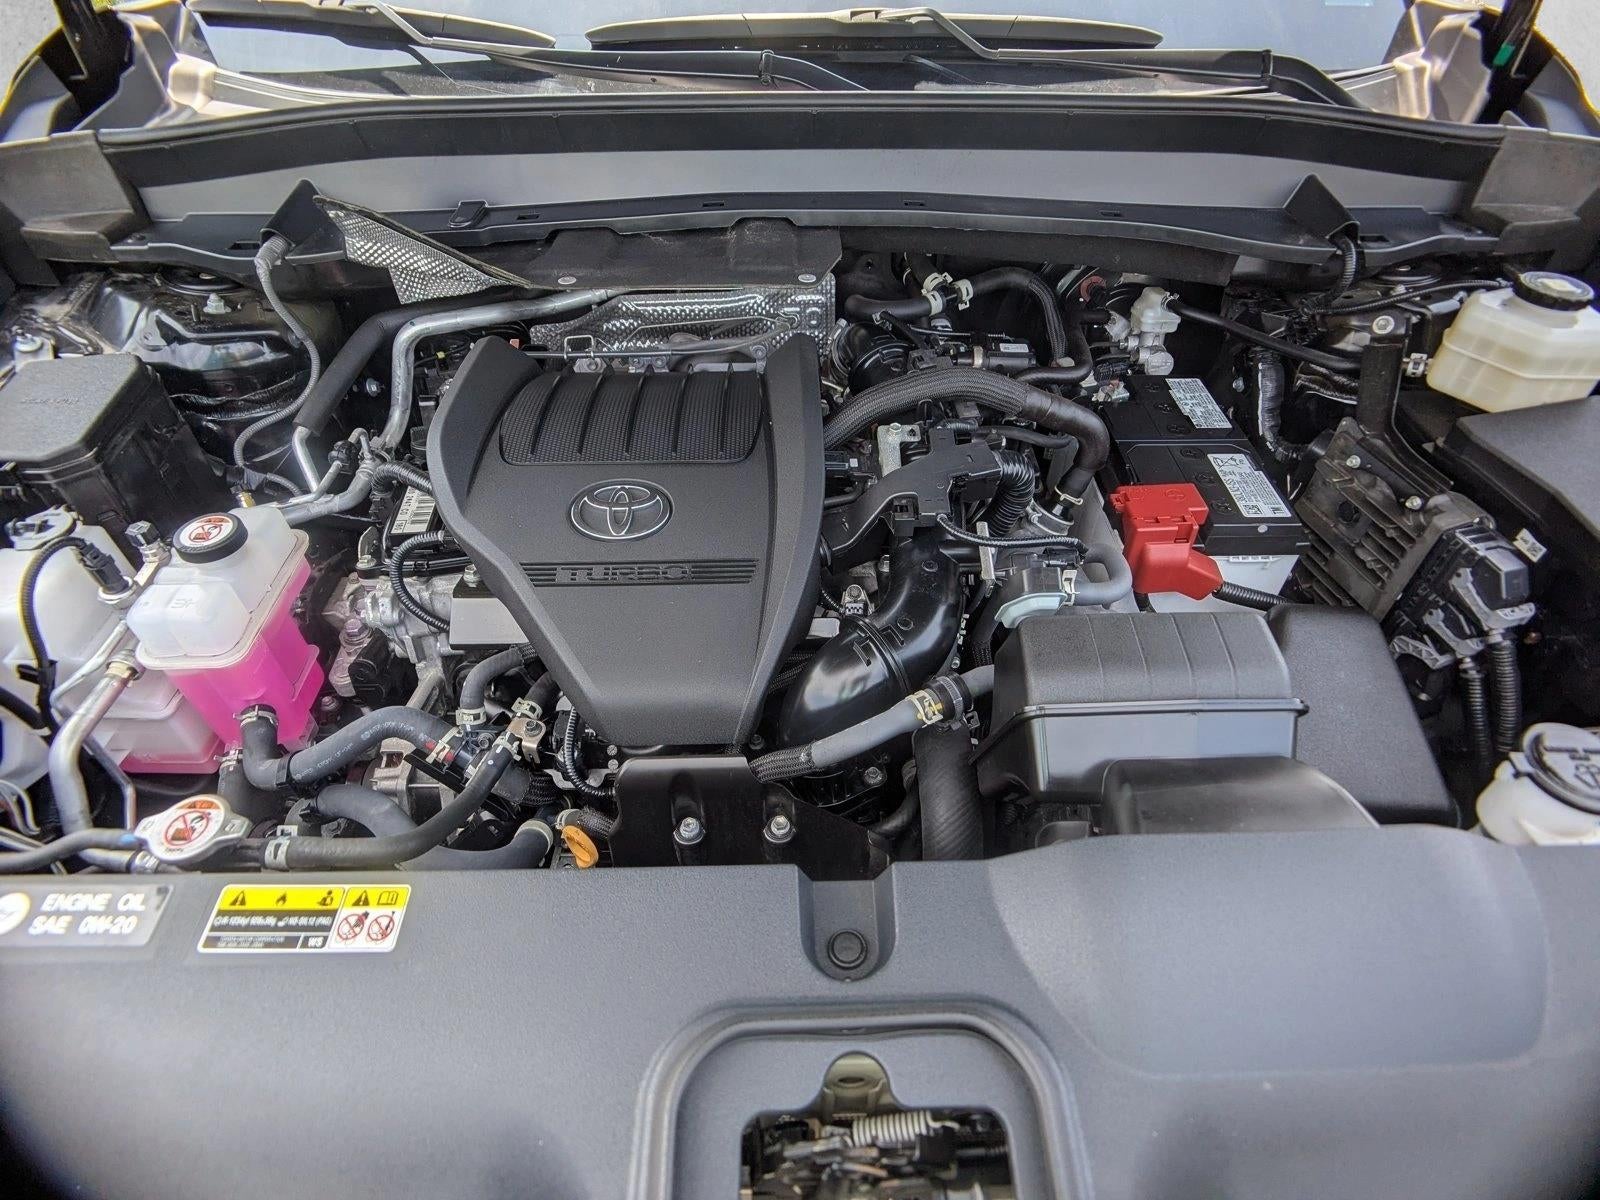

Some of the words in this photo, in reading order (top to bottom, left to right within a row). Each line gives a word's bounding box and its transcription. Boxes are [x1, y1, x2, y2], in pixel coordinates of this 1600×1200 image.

[559, 564, 689, 582] TURBO
[40, 893, 112, 911] ENGINE
[117, 893, 146, 911] OIL
[28, 915, 72, 934] SAE
[78, 915, 138, 934] 0W-20
